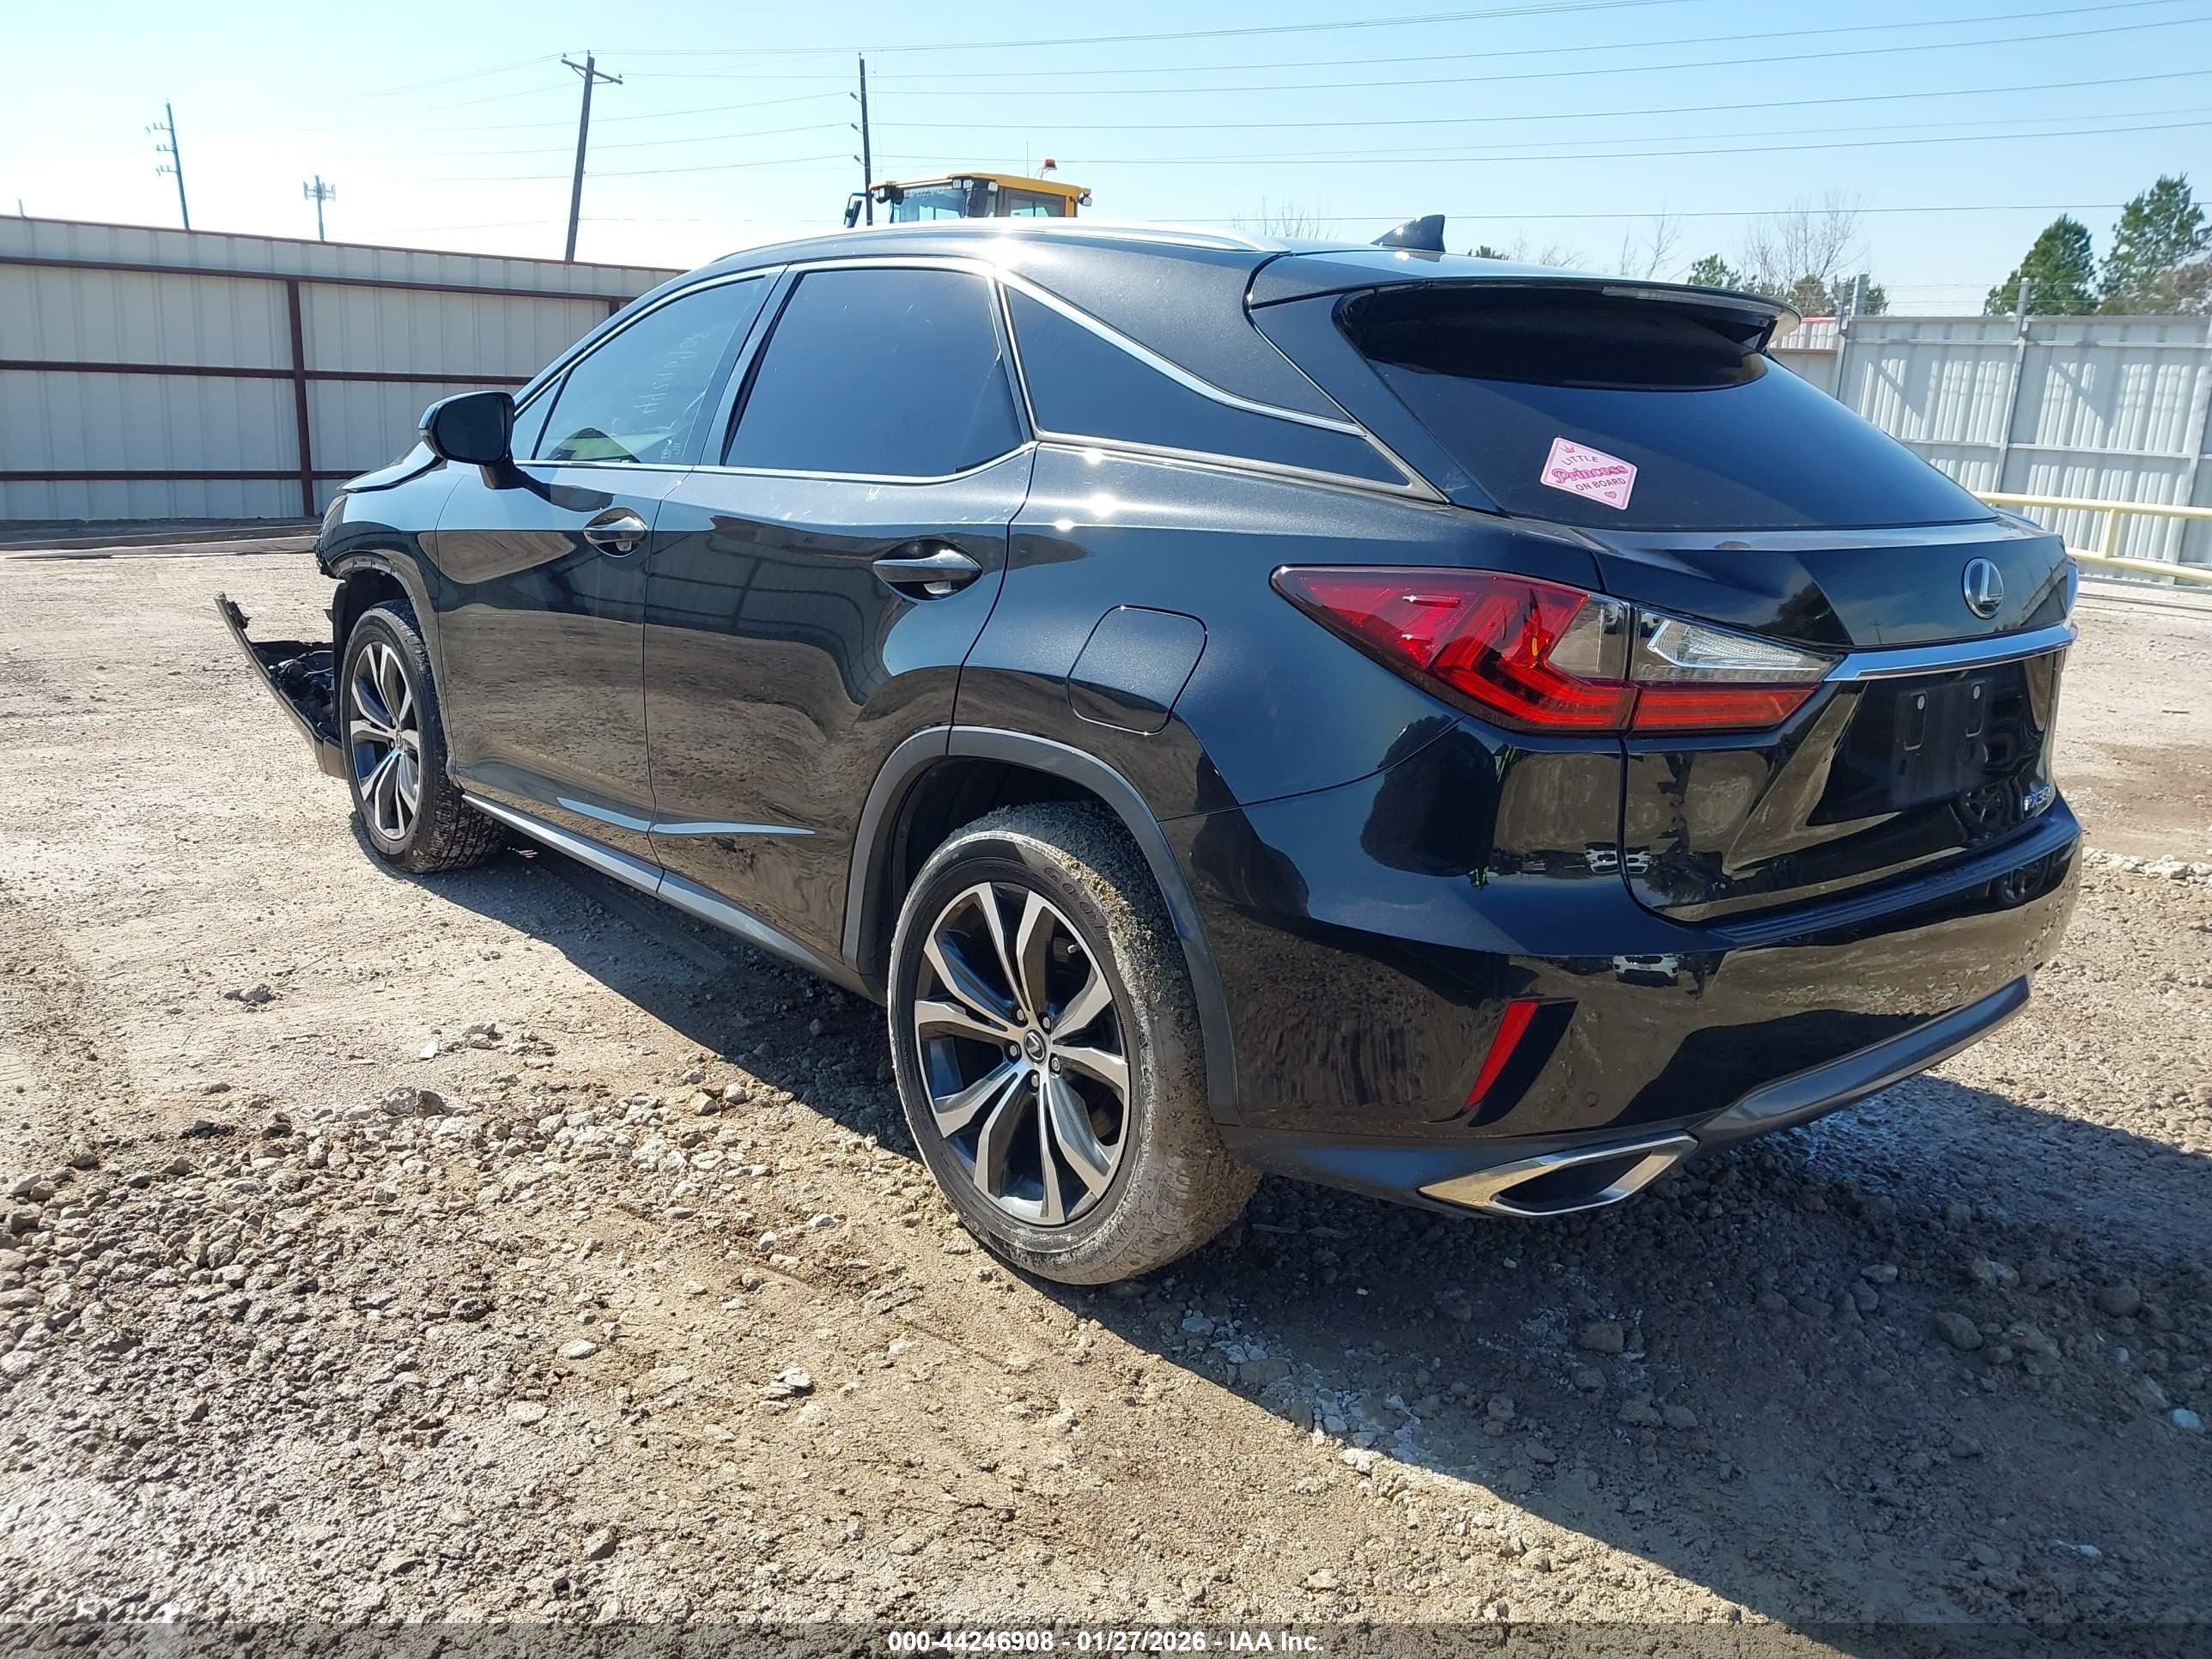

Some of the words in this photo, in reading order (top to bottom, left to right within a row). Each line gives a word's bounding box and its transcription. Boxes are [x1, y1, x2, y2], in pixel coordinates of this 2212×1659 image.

[1561, 455, 1599, 466] LITTLE
[1551, 465, 1629, 483] Princess
[1575, 482, 1592, 491] ON
[1592, 477, 1626, 489] BOARD
